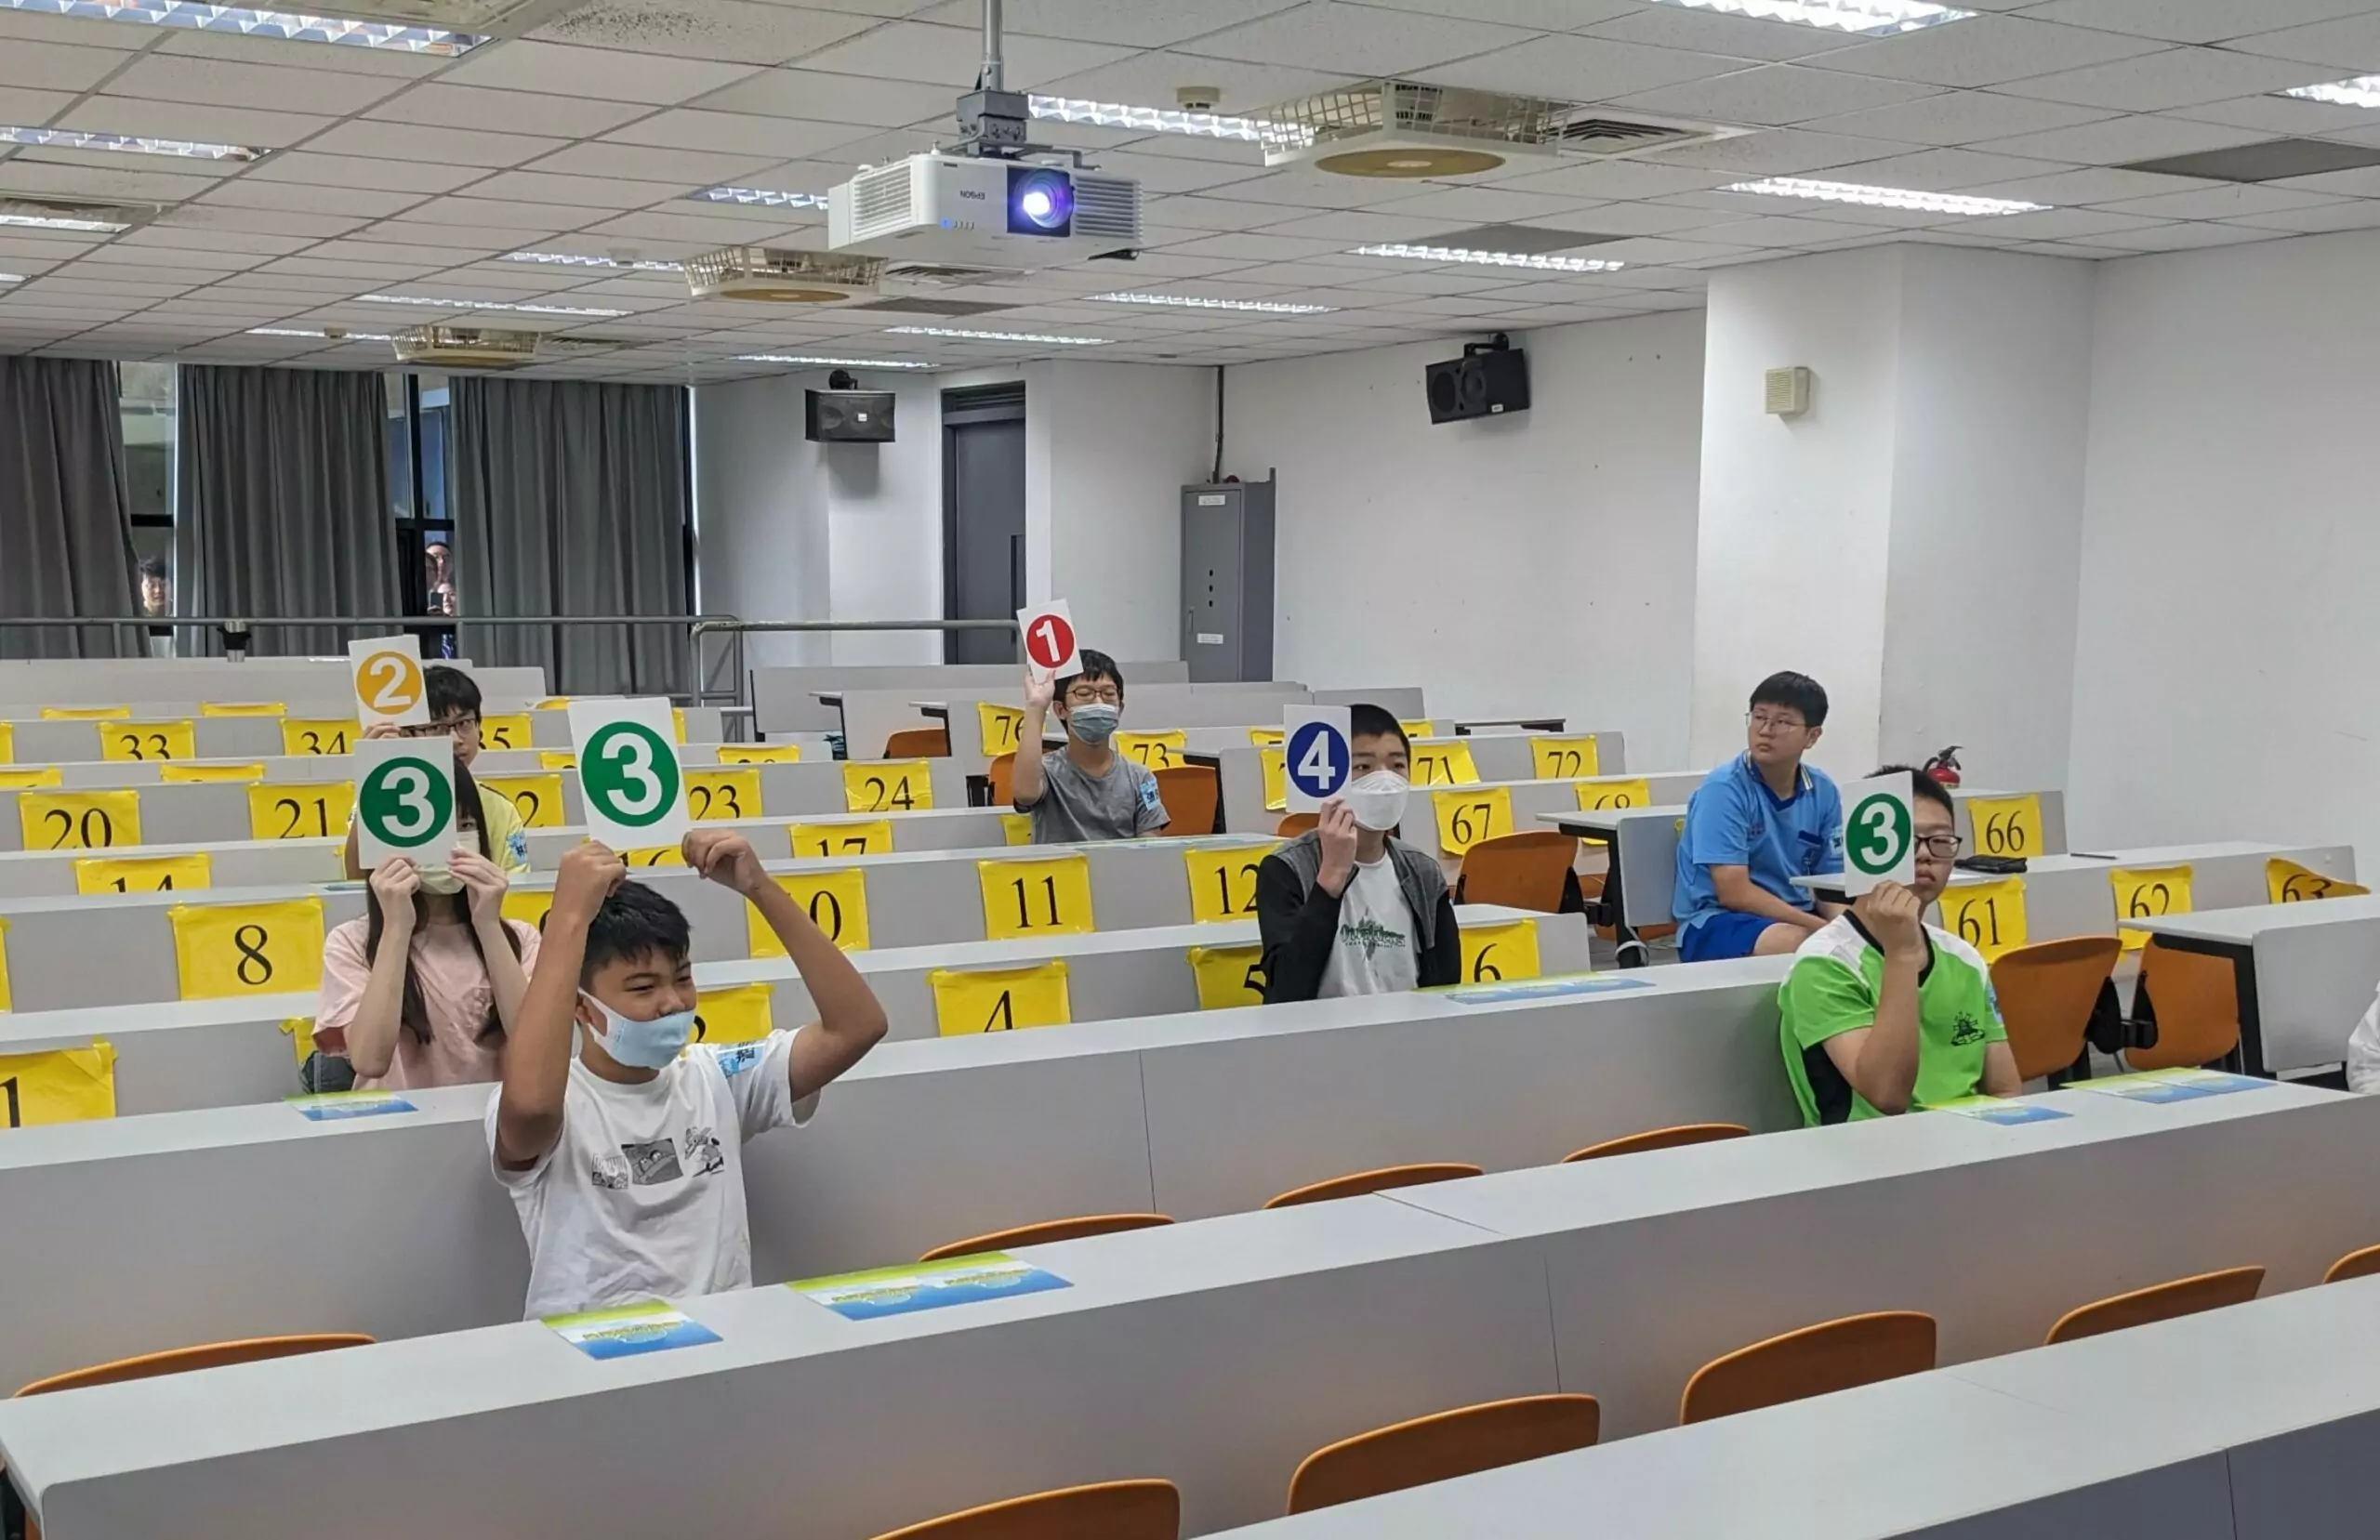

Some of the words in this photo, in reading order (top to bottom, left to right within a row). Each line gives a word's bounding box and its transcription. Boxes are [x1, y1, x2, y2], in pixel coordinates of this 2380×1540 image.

[1036, 620, 1061, 663] 1
[370, 657, 412, 708] 2
[121, 734, 170, 760] 33
[301, 731, 345, 755] 34
[1132, 744, 1170, 768] 73
[1297, 731, 1336, 790] 4
[602, 732, 662, 815] 3
[1417, 756, 1455, 785] 71
[1547, 750, 1581, 779] 72
[381, 767, 435, 837] 3
[689, 784, 741, 821] 23
[865, 776, 915, 812] 24
[44, 808, 112, 849] 20
[275, 798, 327, 839] 21
[1451, 804, 1491, 844] 67
[1861, 802, 1899, 865] 3
[1986, 810, 2025, 853] 66
[1011, 875, 1063, 928] 11
[2130, 883, 2170, 918] 62
[1958, 897, 2000, 948] 61
[234, 925, 272, 985] 8
